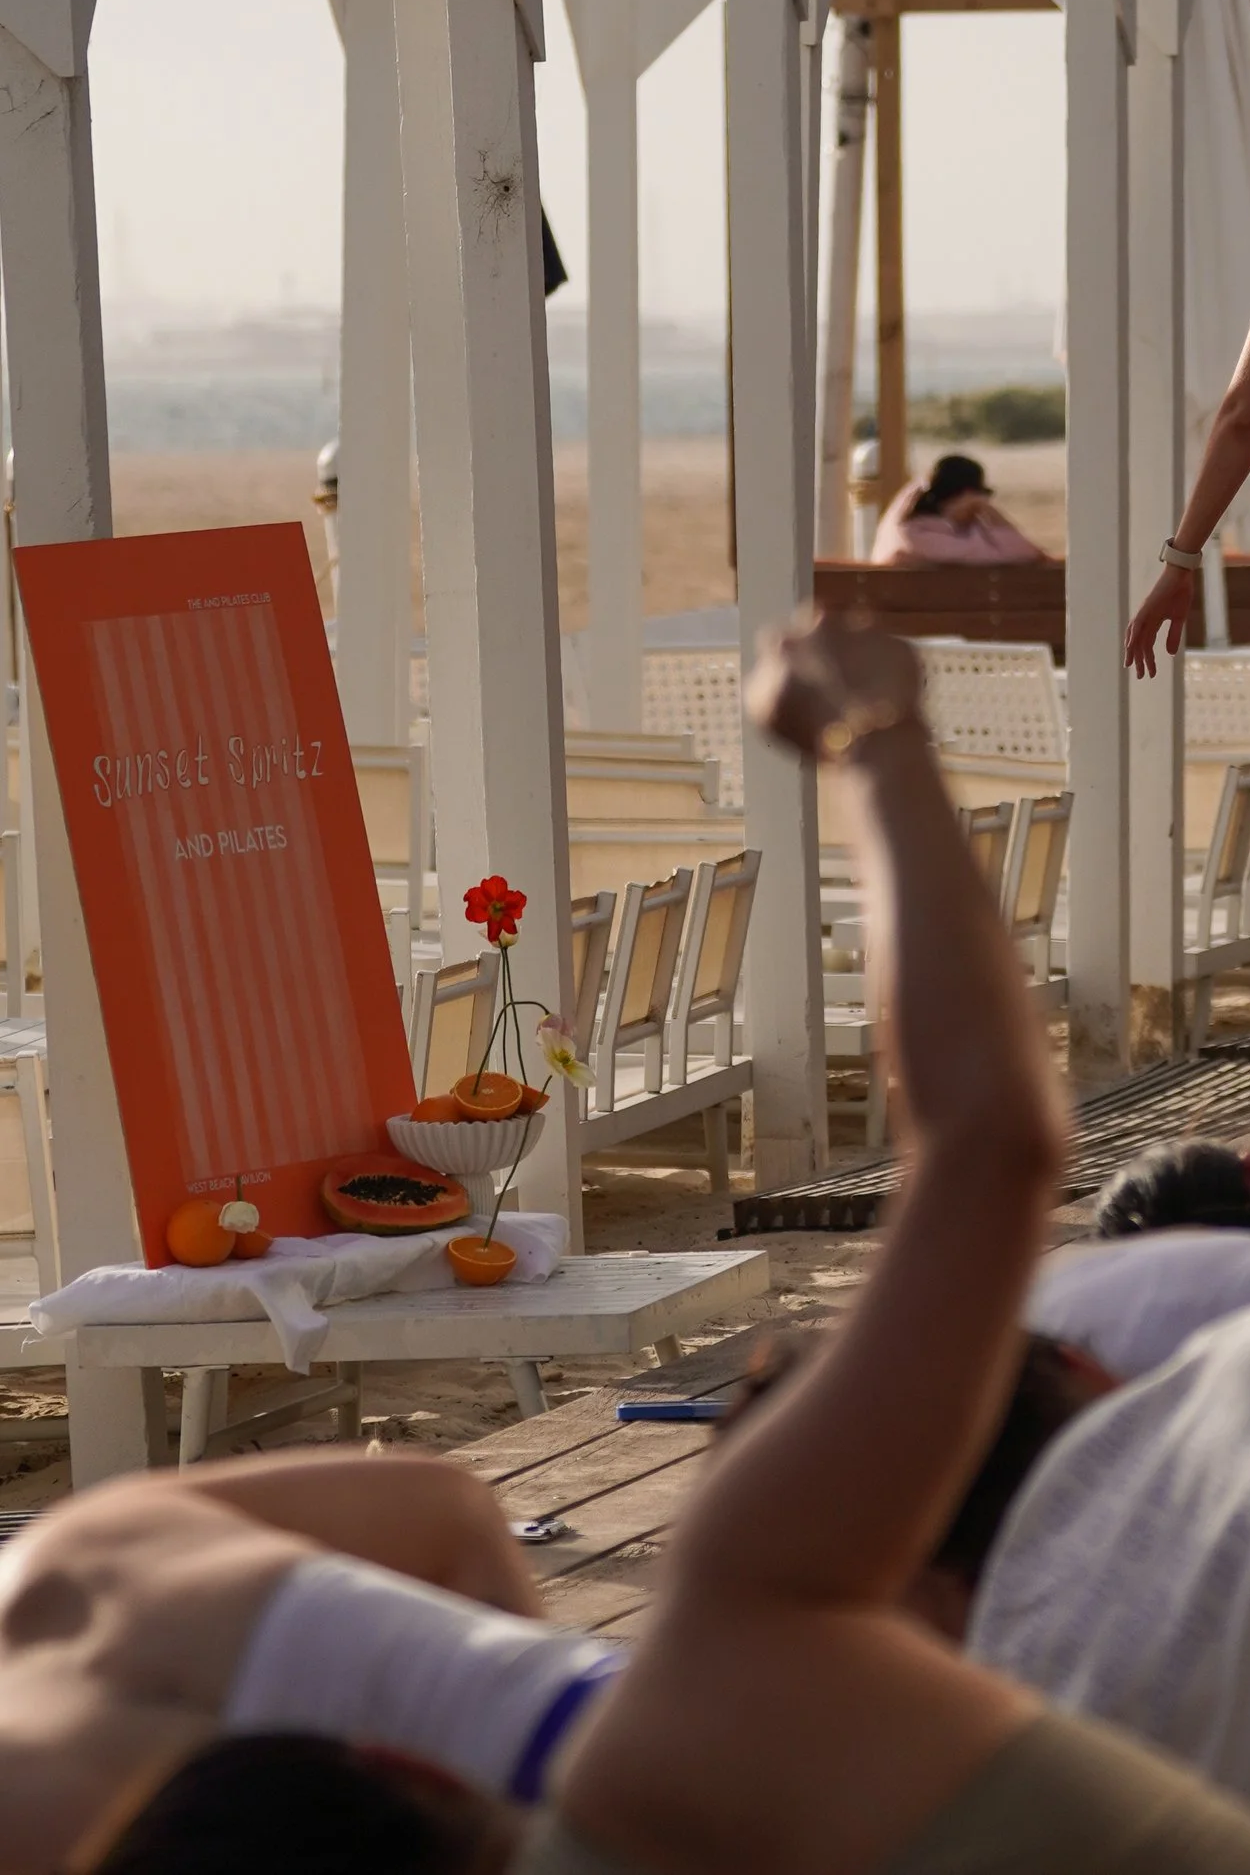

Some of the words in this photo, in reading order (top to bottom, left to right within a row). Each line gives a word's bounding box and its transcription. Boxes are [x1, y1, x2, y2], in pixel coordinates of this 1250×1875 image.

[187, 598, 202, 610] THE
[204, 597, 220, 608] AND
[220, 593, 251, 606] PILATES
[251, 592, 271, 604] CLUB
[93, 733, 210, 808] Sunset
[228, 732, 324, 790] Spritz
[175, 833, 214, 861] AND
[218, 825, 288, 855] PILATES
[187, 1181, 207, 1194] WEST
[209, 1177, 235, 1191] BEACH
[236, 1171, 272, 1186] AVILION
